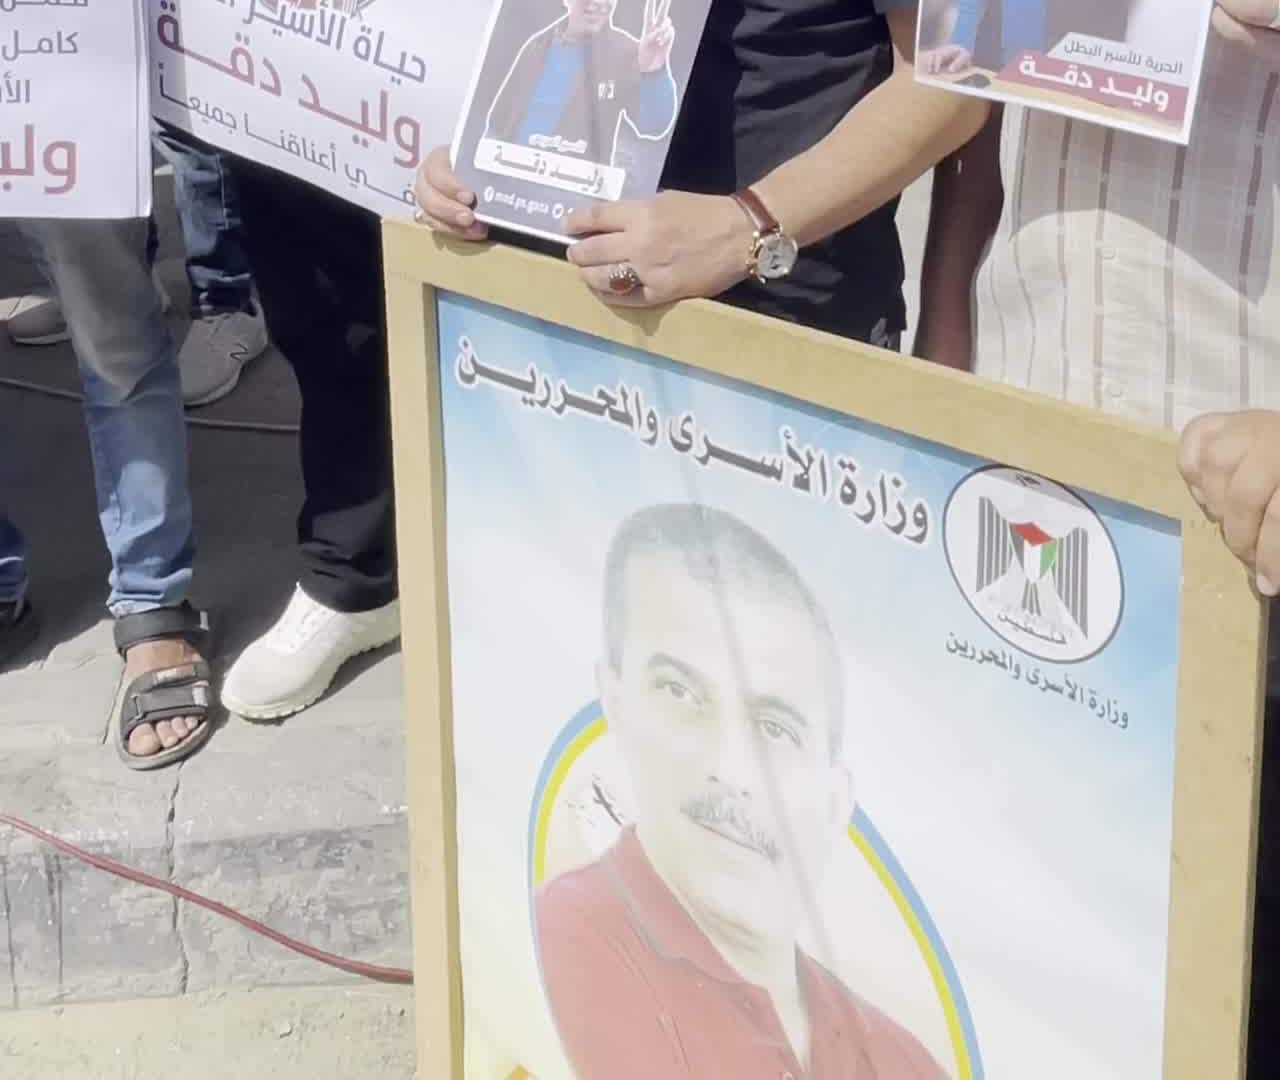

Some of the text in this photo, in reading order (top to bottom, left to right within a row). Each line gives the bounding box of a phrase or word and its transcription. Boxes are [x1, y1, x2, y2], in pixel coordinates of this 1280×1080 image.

[1, 30, 80, 61] كامل
[352, 23, 427, 85] حياة
[1063, 39, 1102, 57] البطل
[1143, 54, 1184, 75] الحرية
[157, 0, 421, 170] وليد دقة
[1018, 55, 1170, 113] وليد دقة
[244, 112, 337, 174] أعناقنا
[345, 162, 417, 208] في
[455, 337, 930, 545] وزارة الأسرى والمحررين
[945, 632, 1130, 731] وزارة الأسرى والمحررين
